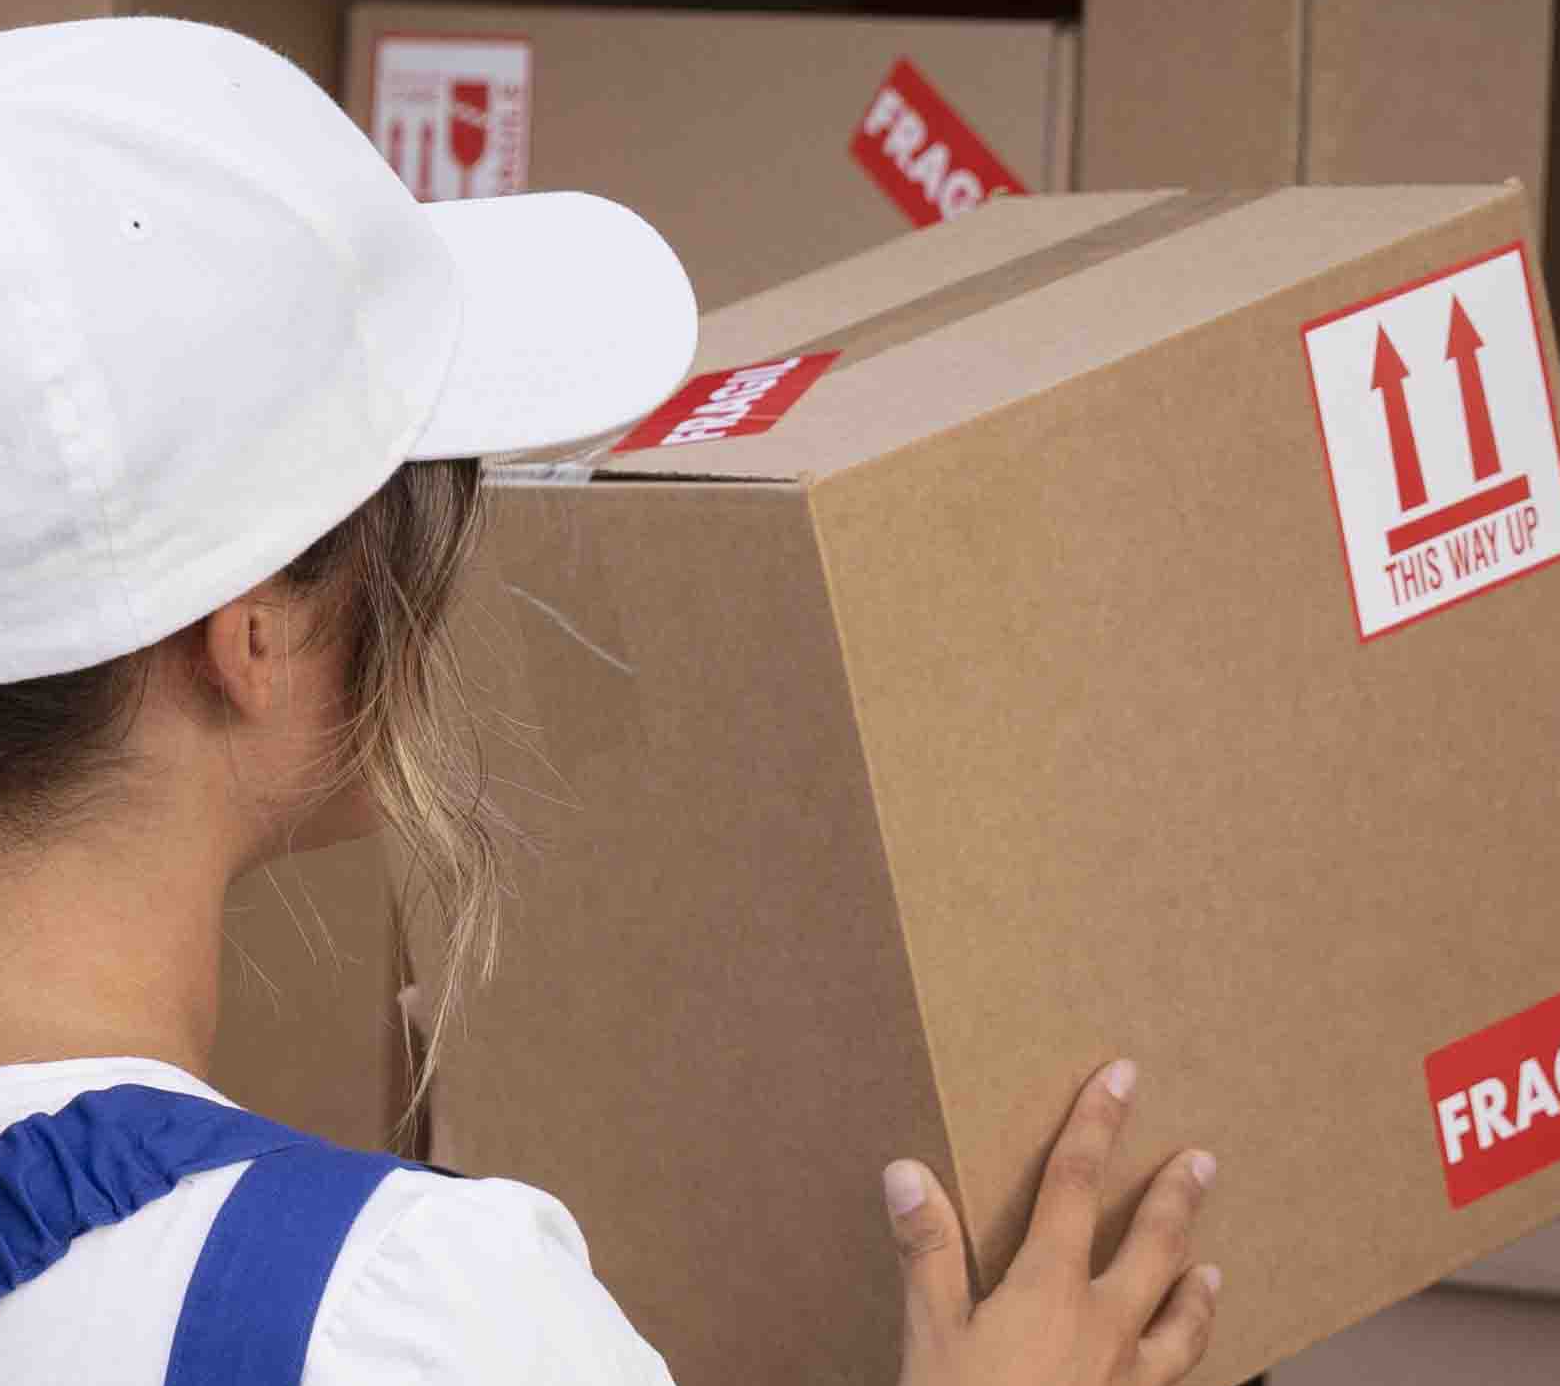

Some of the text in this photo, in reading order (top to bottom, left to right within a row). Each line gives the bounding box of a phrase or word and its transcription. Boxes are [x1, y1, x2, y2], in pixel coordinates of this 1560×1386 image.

[1385, 506, 1539, 606] THIS WAY UP
